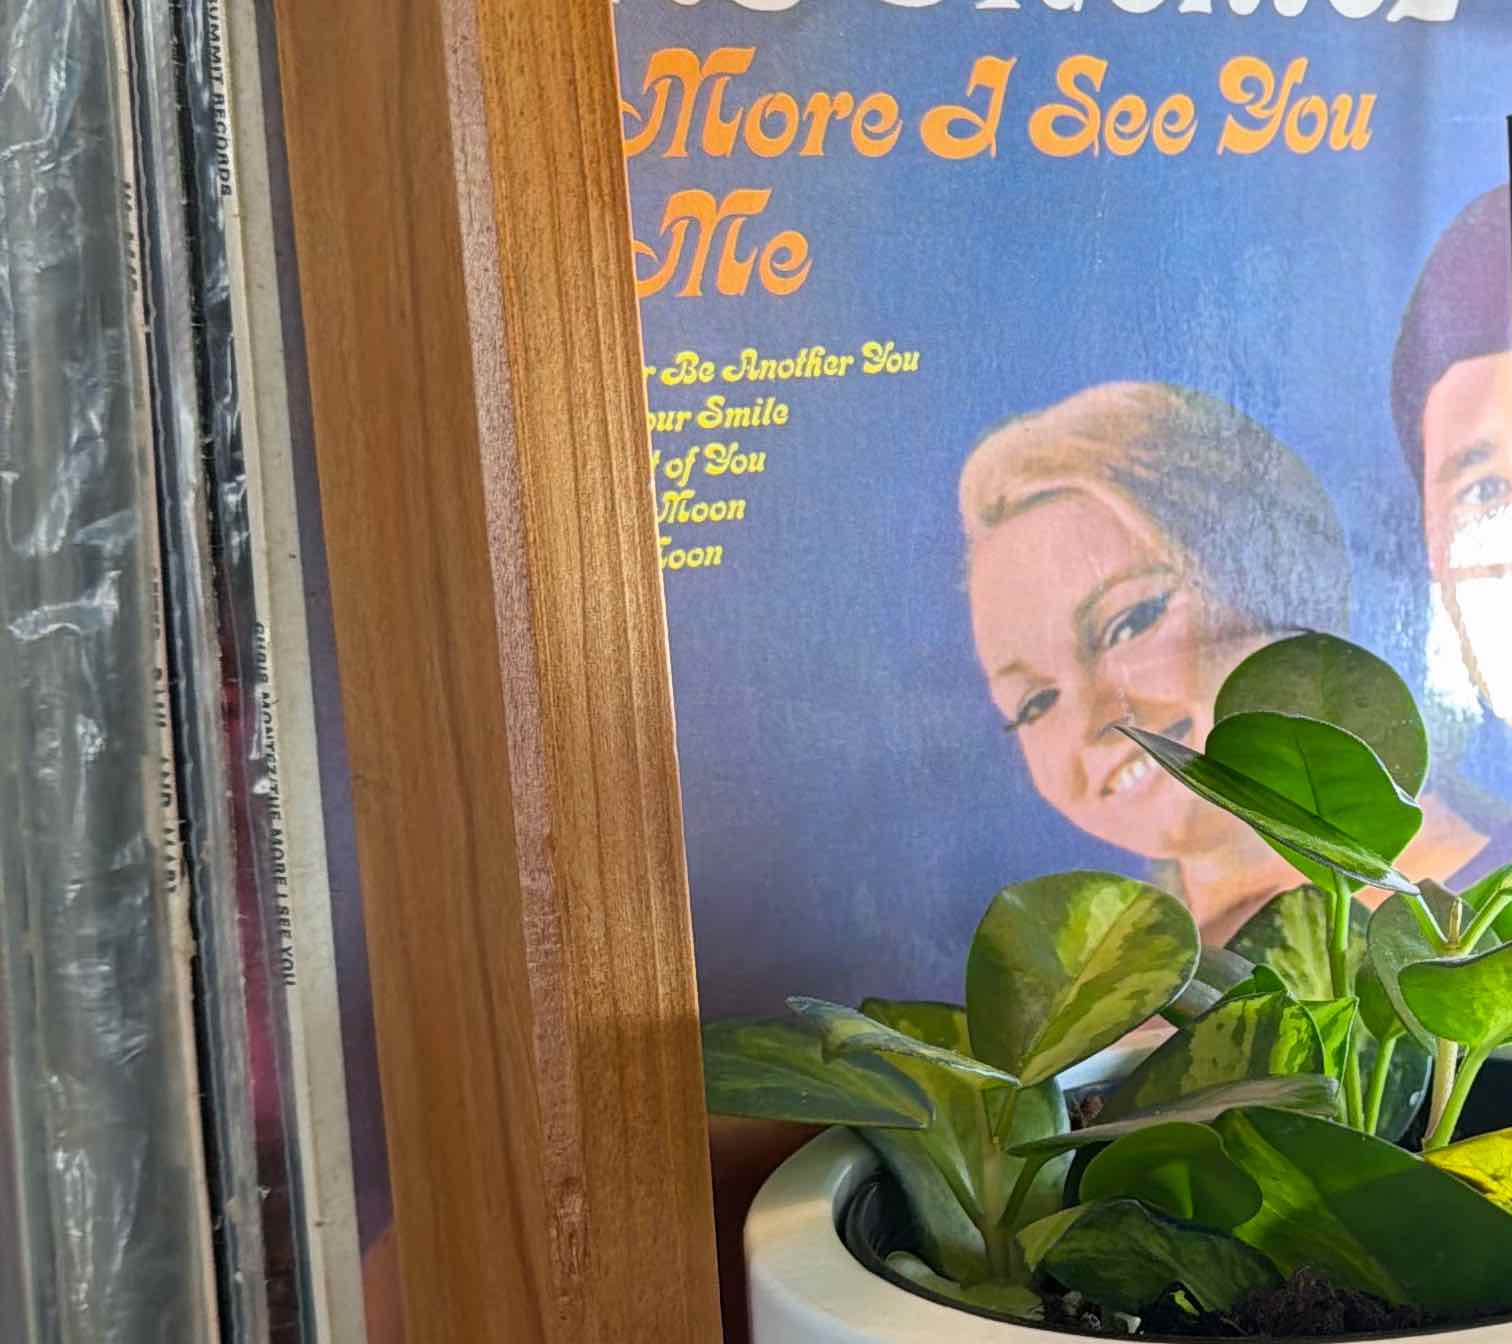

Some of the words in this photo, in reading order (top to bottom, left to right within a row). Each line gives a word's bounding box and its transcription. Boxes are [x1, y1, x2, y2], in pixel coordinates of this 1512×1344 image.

[621, 47, 904, 160] More
[1027, 56, 1198, 157] See
[1218, 56, 1377, 157] You
[212, 93, 233, 197] RECORDS
[634, 188, 812, 298] Me
[660, 350, 716, 386] Be
[721, 345, 856, 383] Another
[860, 341, 921, 375] You
[697, 395, 790, 430] Smile
[664, 447, 699, 488] of
[703, 441, 767, 476] You
[656, 489, 747, 525] Moon
